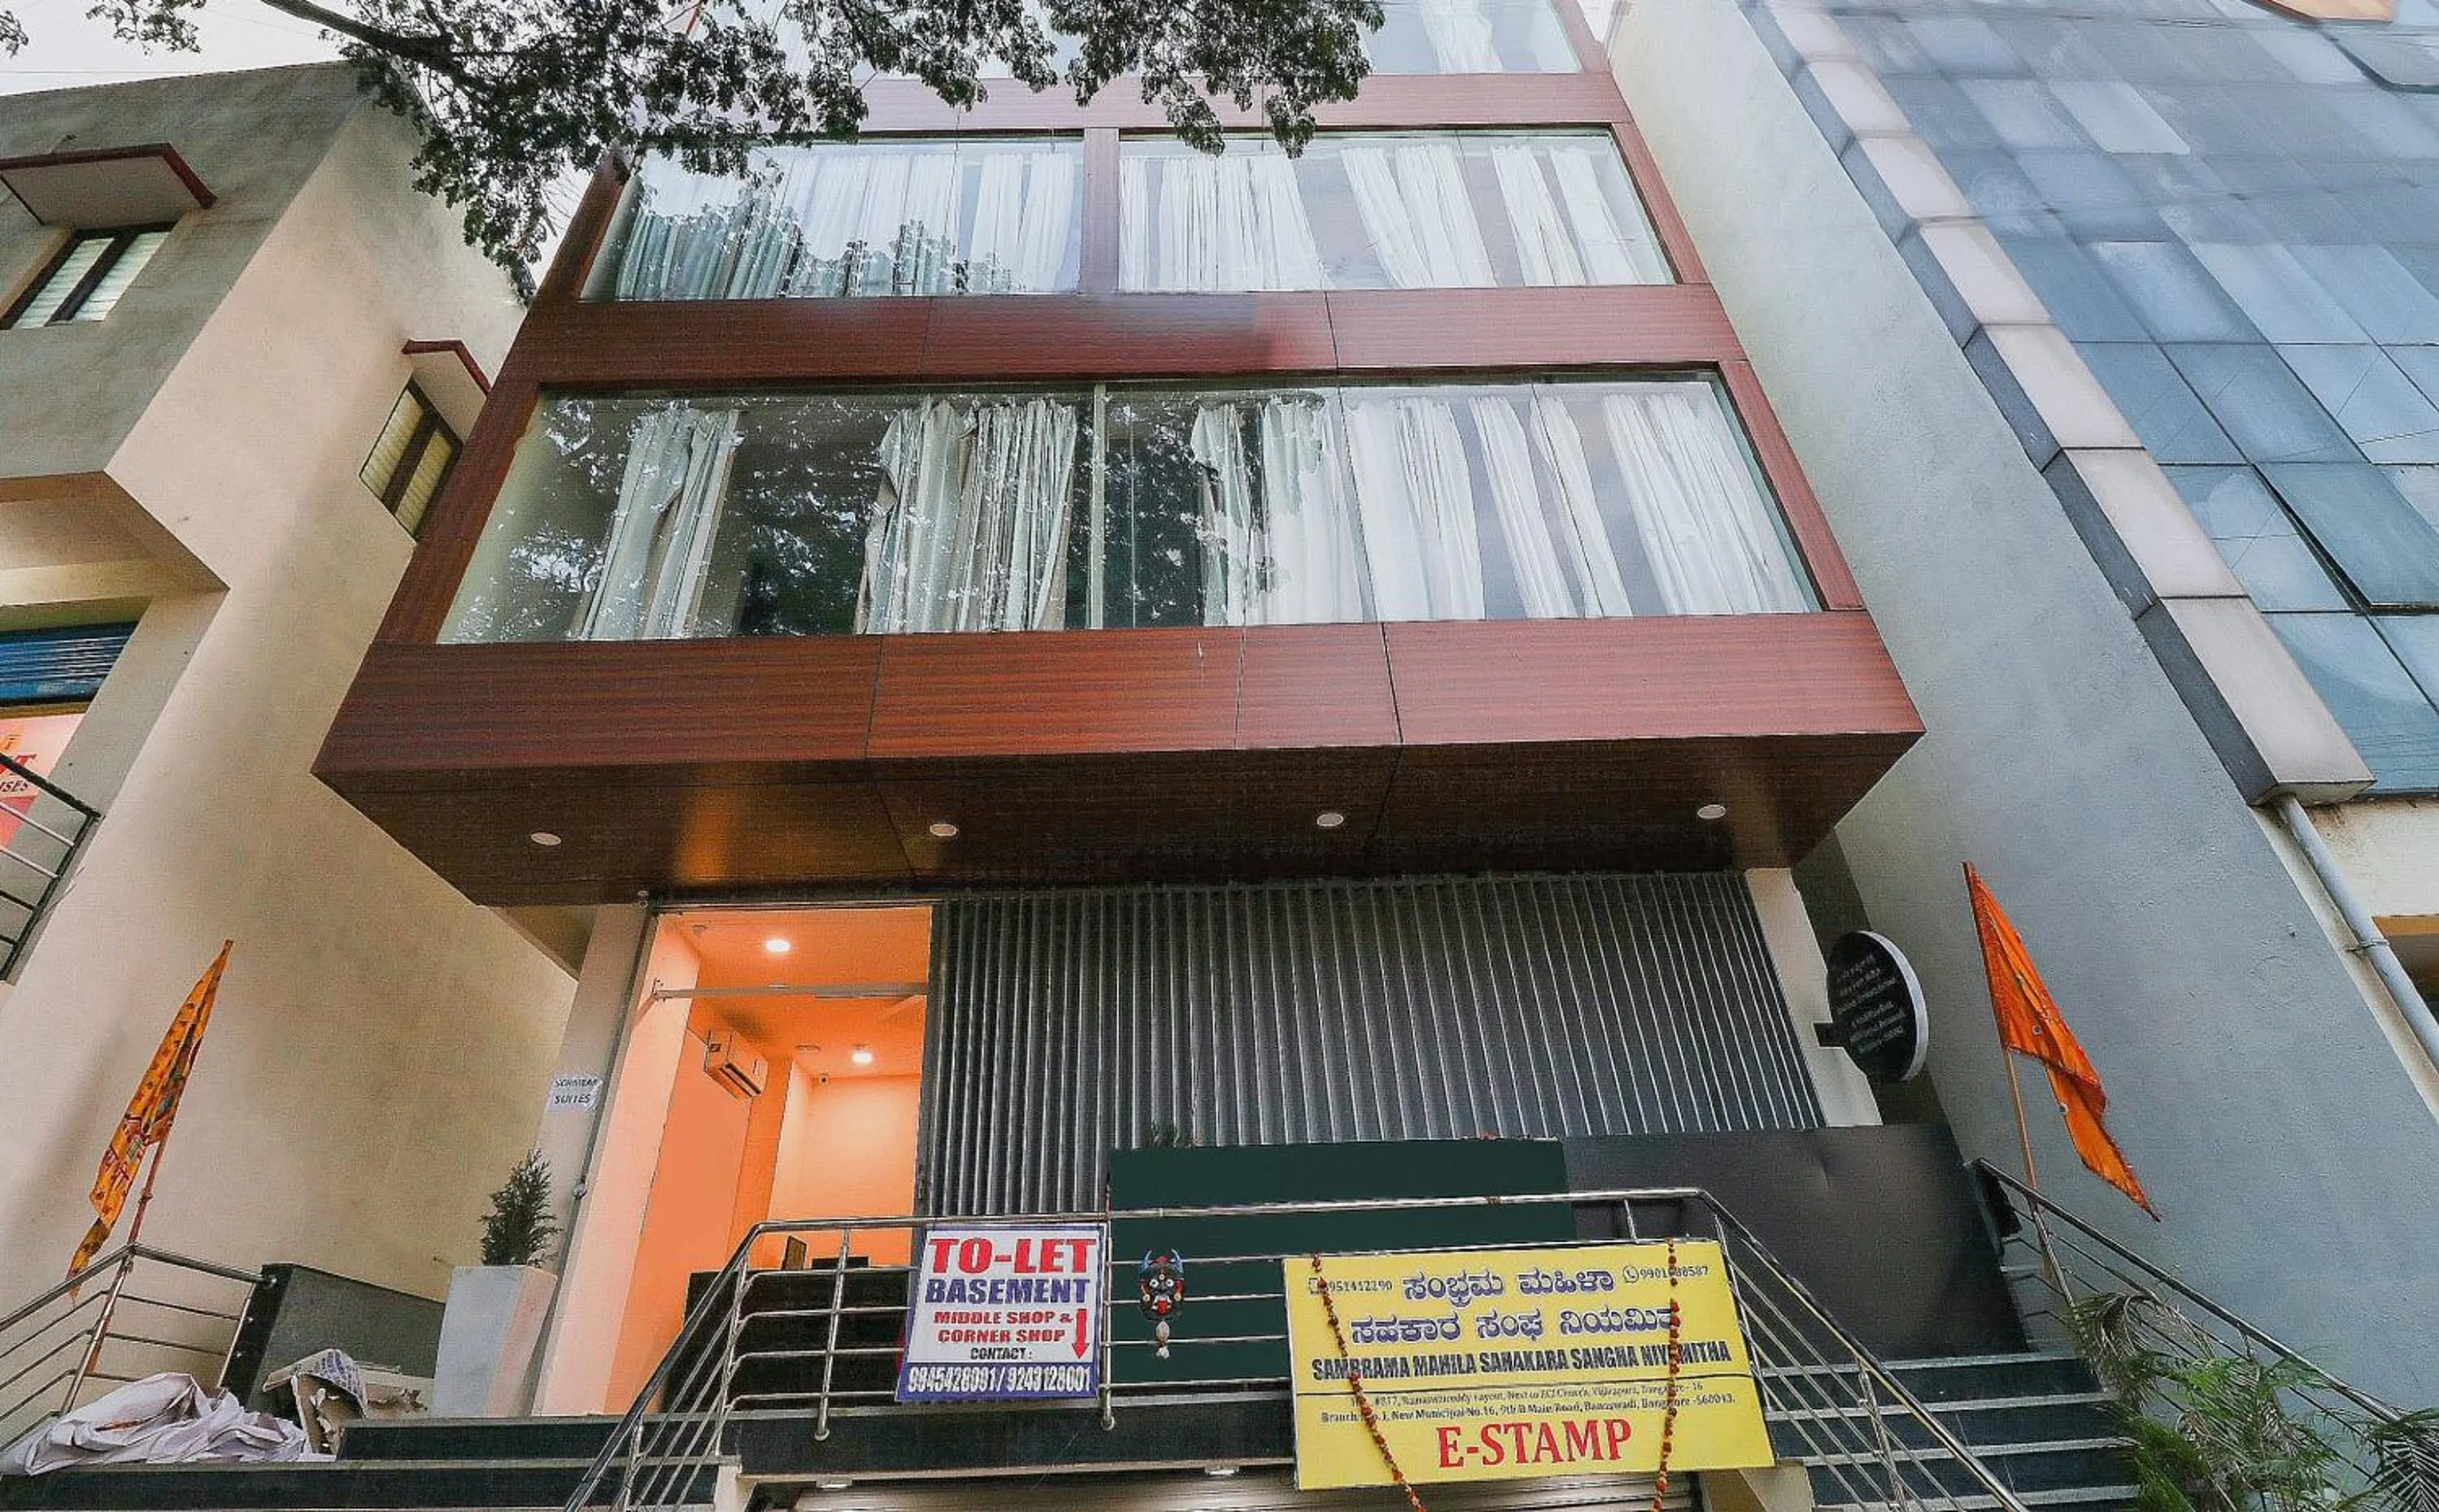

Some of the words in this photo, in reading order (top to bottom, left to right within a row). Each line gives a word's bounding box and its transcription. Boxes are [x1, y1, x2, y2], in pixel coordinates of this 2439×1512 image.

[554, 1093, 591, 1105] SUITES
[929, 1237, 1097, 1274] TO-LET
[925, 1278, 1091, 1304] BASEMENT
[1402, 1267, 1504, 1307] ಸಂಭ್ರಮ
[1518, 1267, 1615, 1294] ಮಹಿಳಾ
[934, 1311, 1002, 1324] MIDDLE
[1006, 1311, 1056, 1324] SHOP
[1059, 1313, 1074, 1323] &
[1350, 1310, 1462, 1344] ಸಹಕಾರ
[1476, 1308, 1543, 1341] ಸಂಘ
[937, 1329, 1011, 1342] CORNER
[1016, 1329, 1067, 1342] SHOP
[1412, 1354, 1476, 1377] MAHILA
[1478, 1349, 1569, 1373] SAHAKARA
[1571, 1345, 1639, 1370] SANGHA
[1436, 1418, 1633, 1469] E-STAMP
